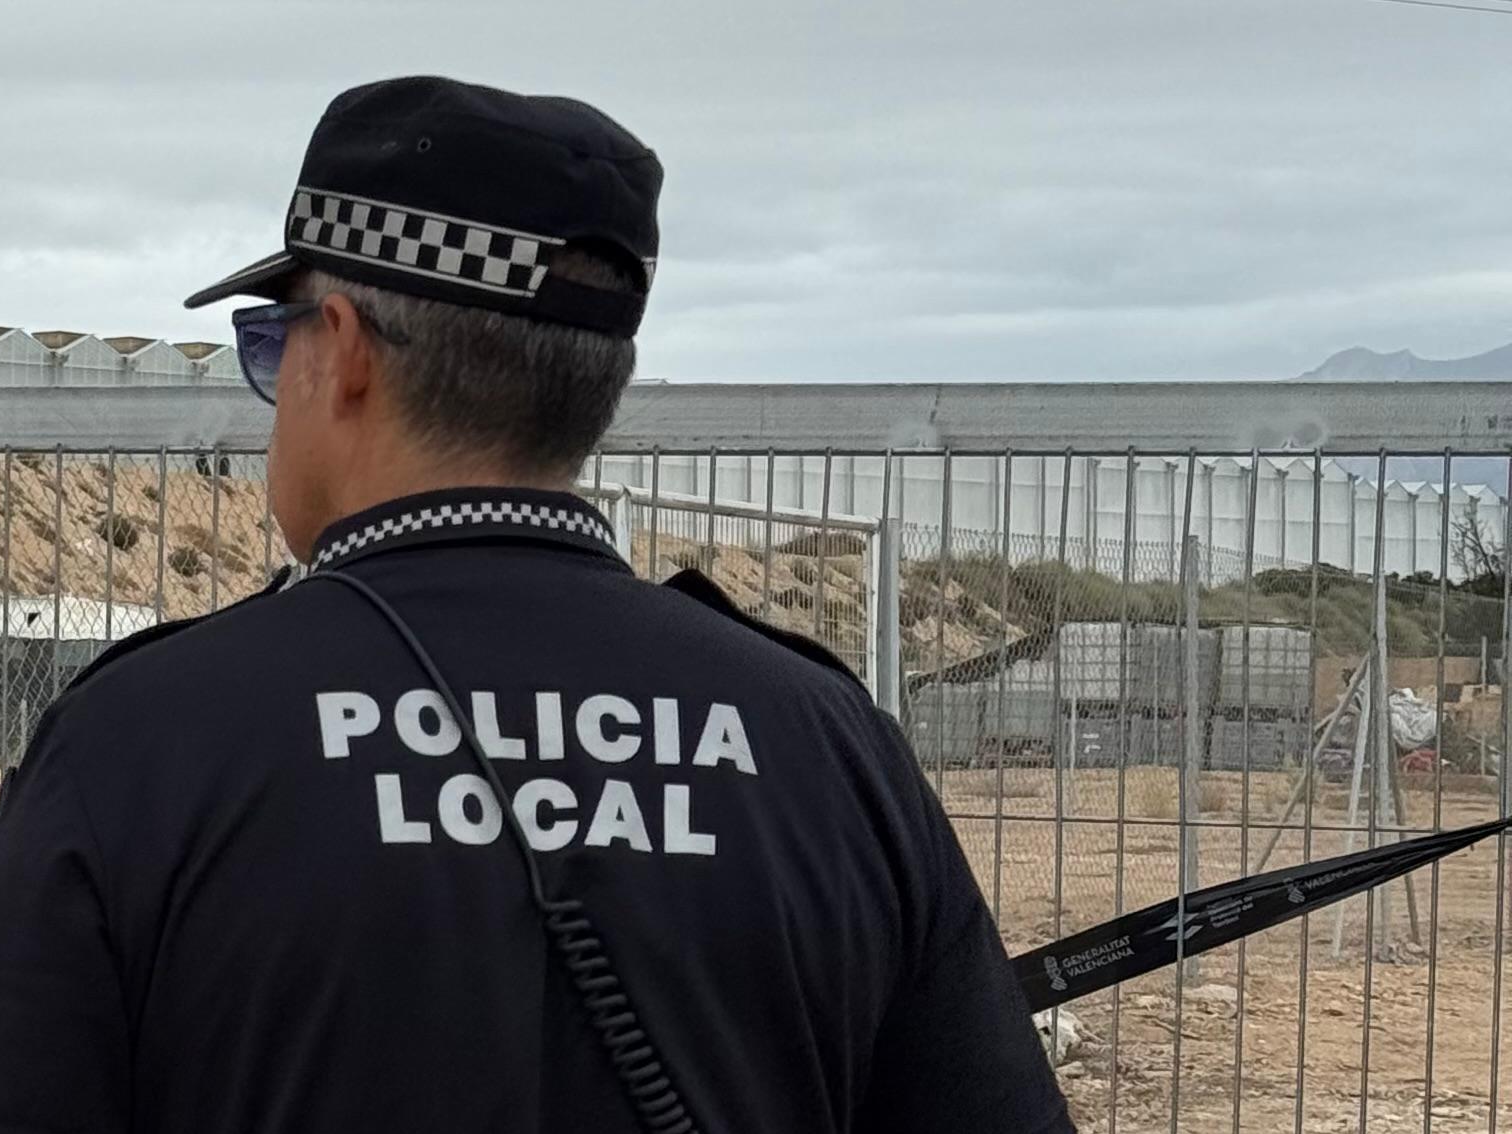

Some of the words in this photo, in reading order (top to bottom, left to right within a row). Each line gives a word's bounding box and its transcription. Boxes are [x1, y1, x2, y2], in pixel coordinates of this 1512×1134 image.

[315, 688, 758, 775] POLICIA
[374, 773, 716, 855] LOCAL
[1062, 935, 1131, 968] GENERALITAT
[1066, 947, 1135, 977] VALENCIANA
